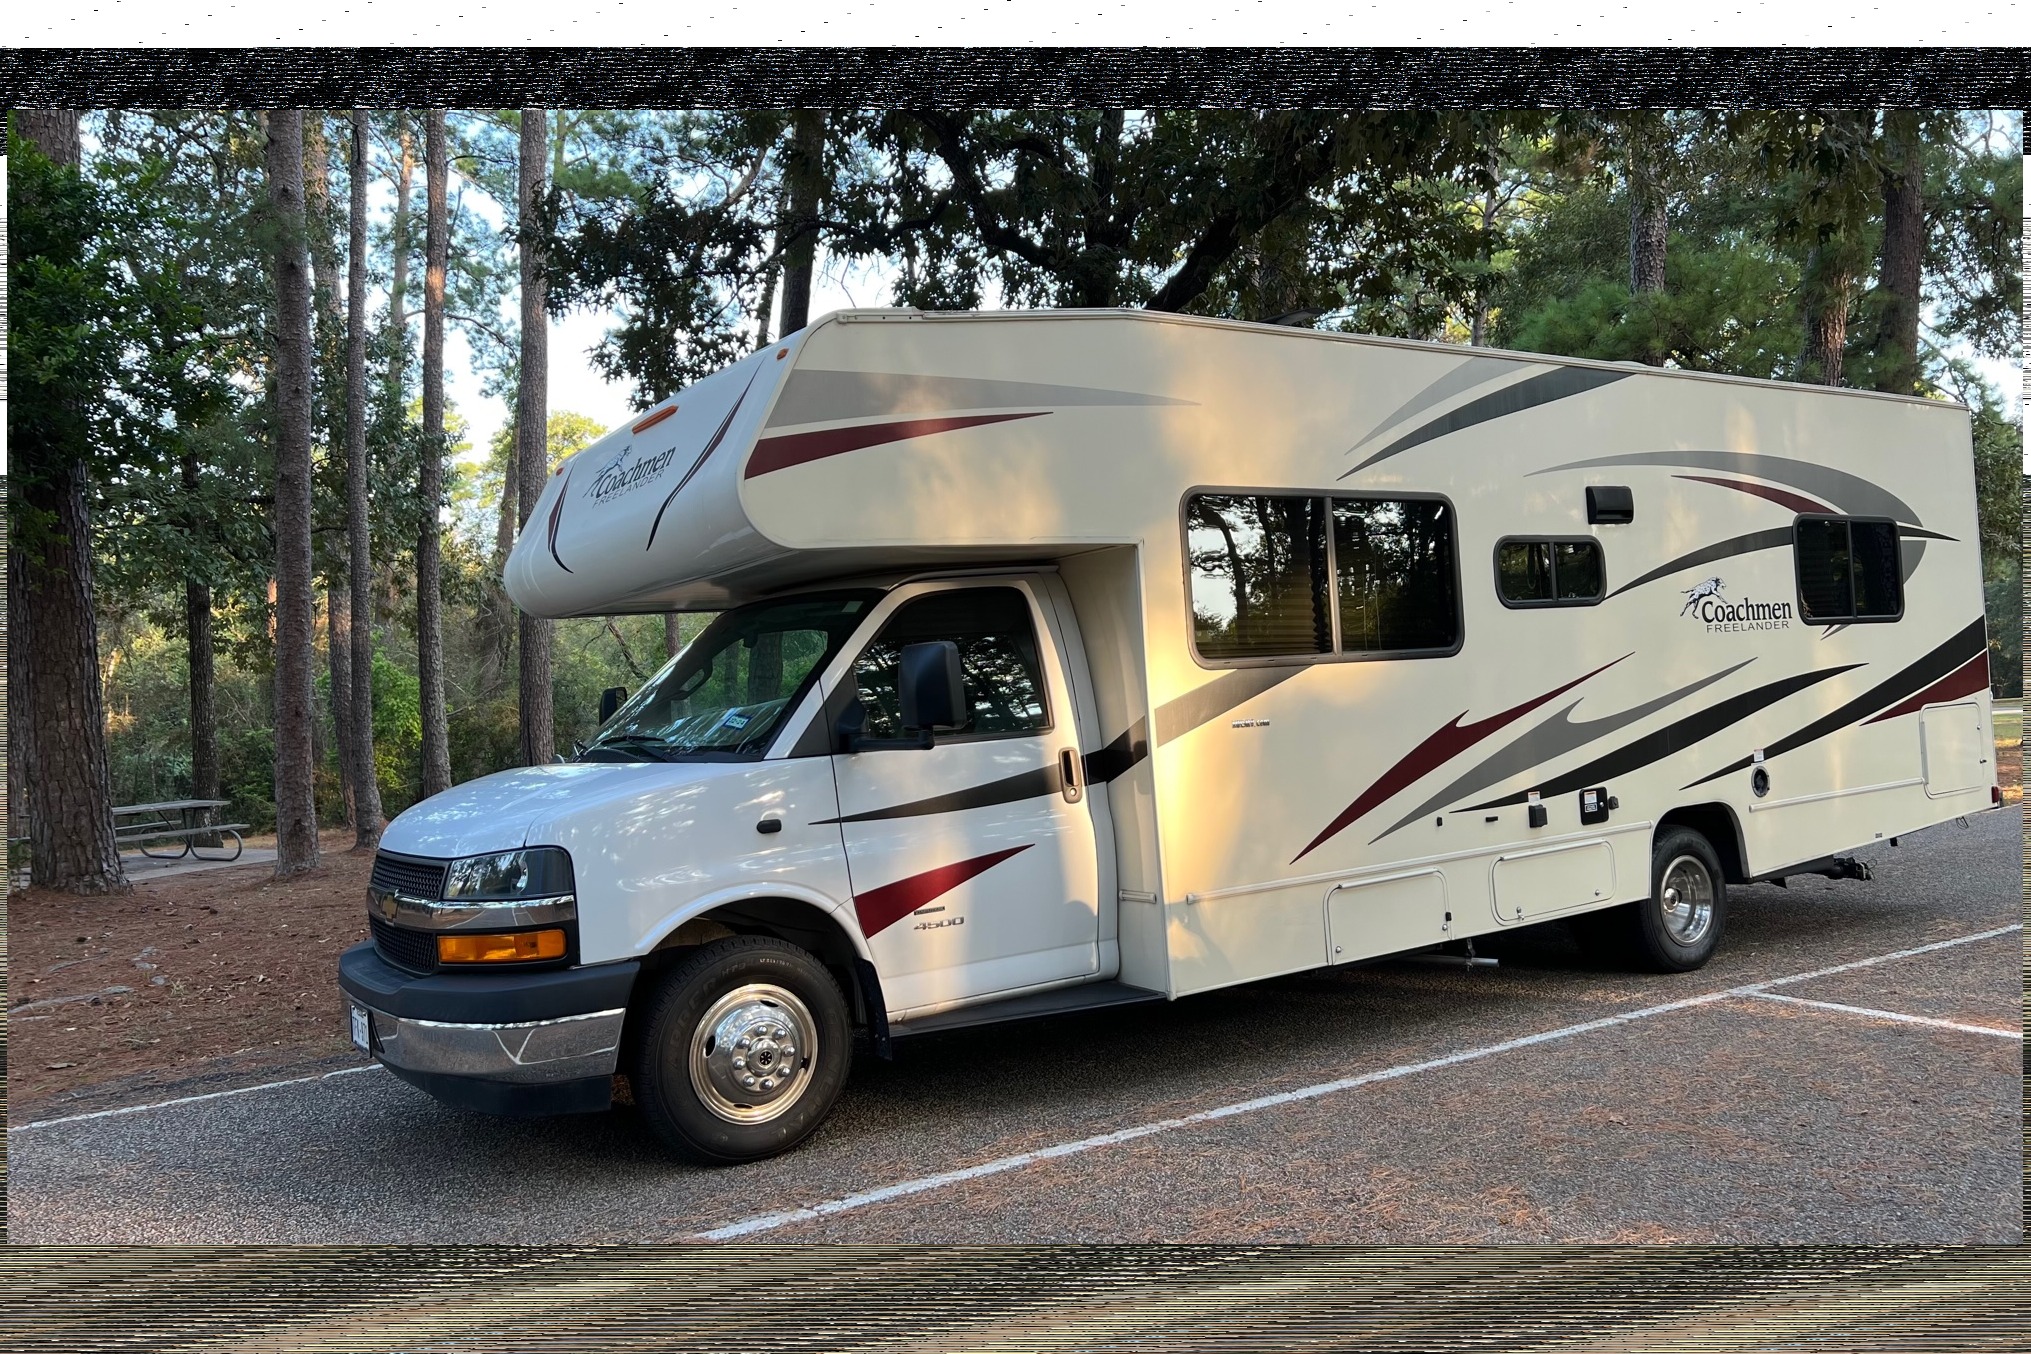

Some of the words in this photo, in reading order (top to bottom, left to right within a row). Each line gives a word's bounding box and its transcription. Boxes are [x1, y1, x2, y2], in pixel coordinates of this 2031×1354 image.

[596, 446, 676, 499] Coachmen
[592, 469, 664, 509] FREELANDER
[1701, 597, 1792, 623] Coachmen
[1706, 620, 1790, 633] FREELANDER
[914, 916, 964, 930] 4500
